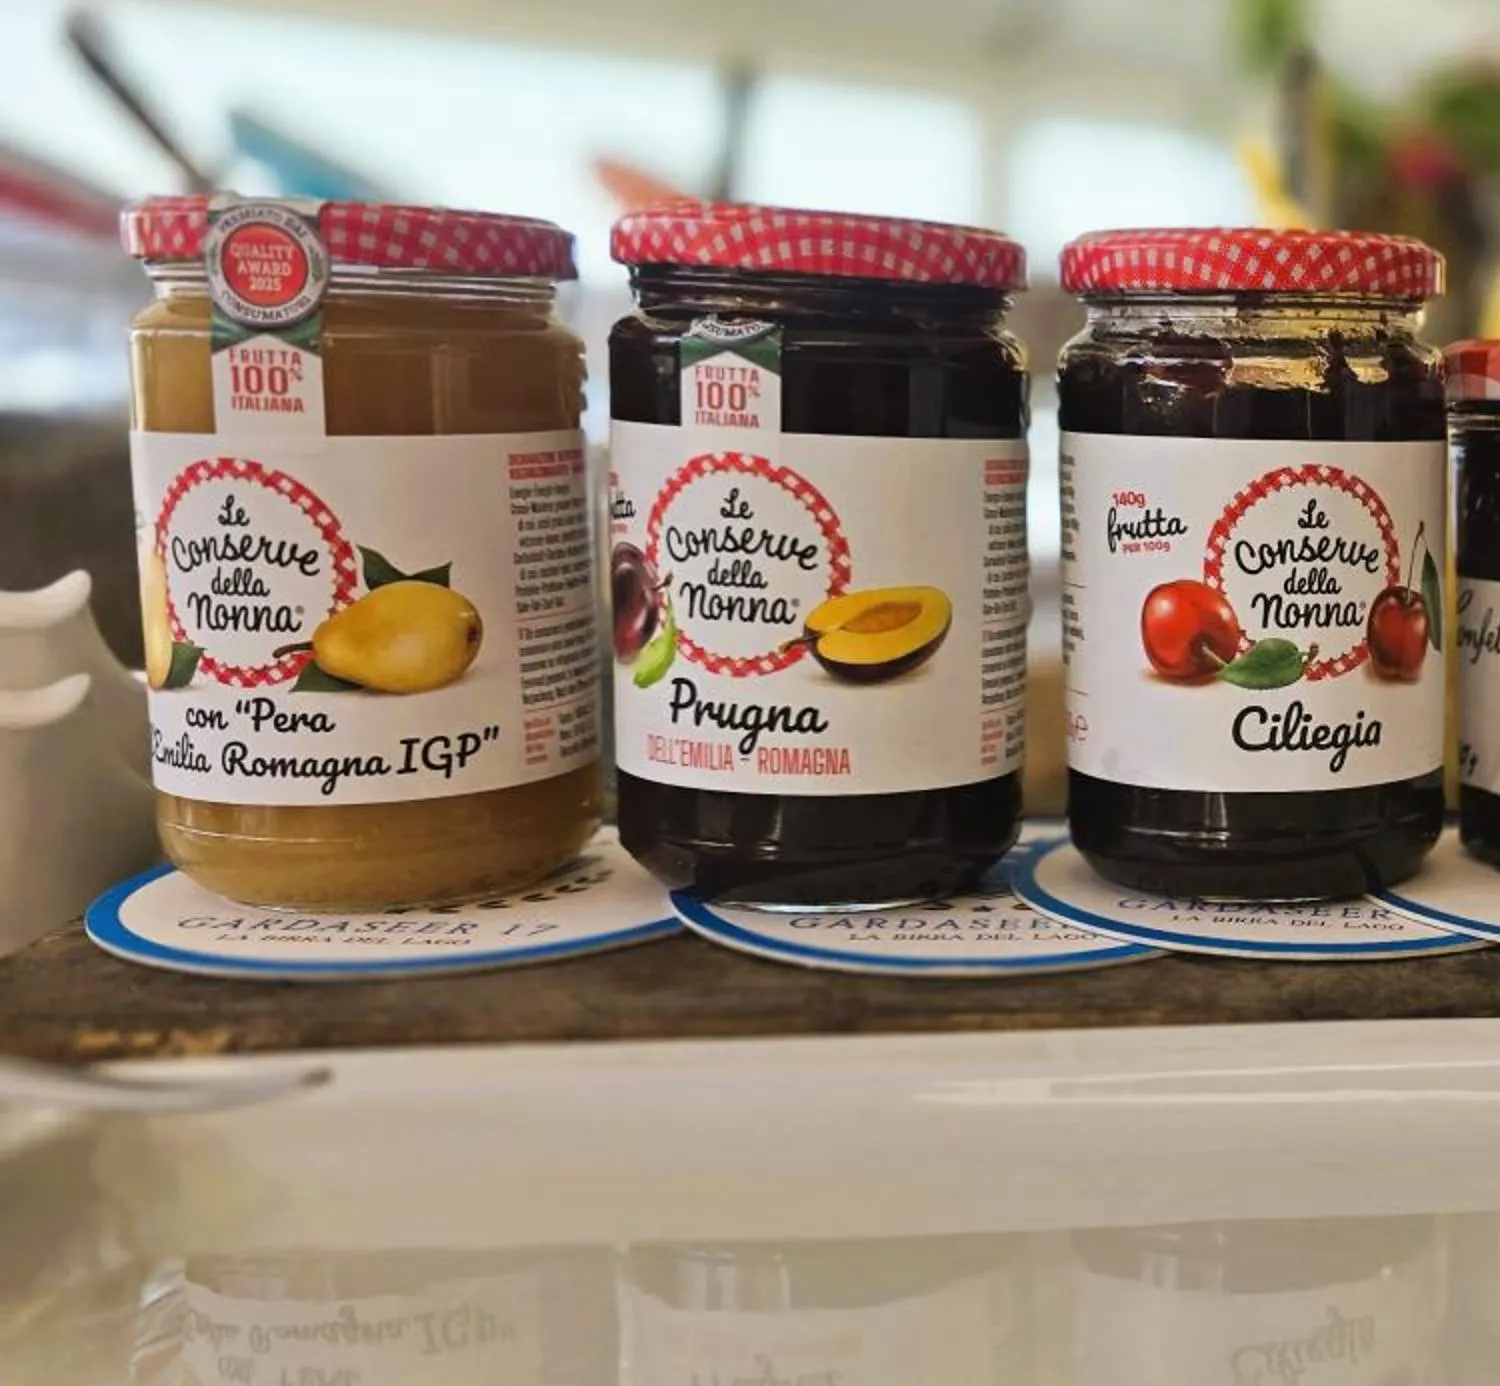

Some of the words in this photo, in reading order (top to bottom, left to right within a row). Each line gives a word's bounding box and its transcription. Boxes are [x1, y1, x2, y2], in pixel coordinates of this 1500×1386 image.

[230, 243, 294, 260] QUALITY
[237, 260, 292, 276] AWARD
[228, 348, 303, 366] FRUTTA
[231, 365, 304, 396] 100%
[694, 365, 760, 382] FRUTTA
[231, 394, 305, 414] ITALIANA
[696, 380, 761, 411] 100%
[694, 410, 760, 428] ITALIANA
[218, 494, 250, 527] Le
[719, 487, 755, 520] Le
[1112, 491, 1146, 508] 140g
[1297, 498, 1330, 530] Le
[1107, 507, 1188, 553] frutta
[171, 531, 321, 577] Conserve
[666, 525, 820, 572] Conserve
[1234, 535, 1379, 575] Conserve
[211, 567, 271, 598] della
[706, 557, 769, 590] della
[1283, 566, 1342, 596] della
[185, 706, 228, 730] con
[669, 677, 829, 755] Prugna
[1231, 700, 1383, 773] Ciliegia
[221, 741, 391, 795] Romagna
[646, 734, 735, 772] DELL'EMILIA
[757, 746, 851, 776] ROMAGNA
